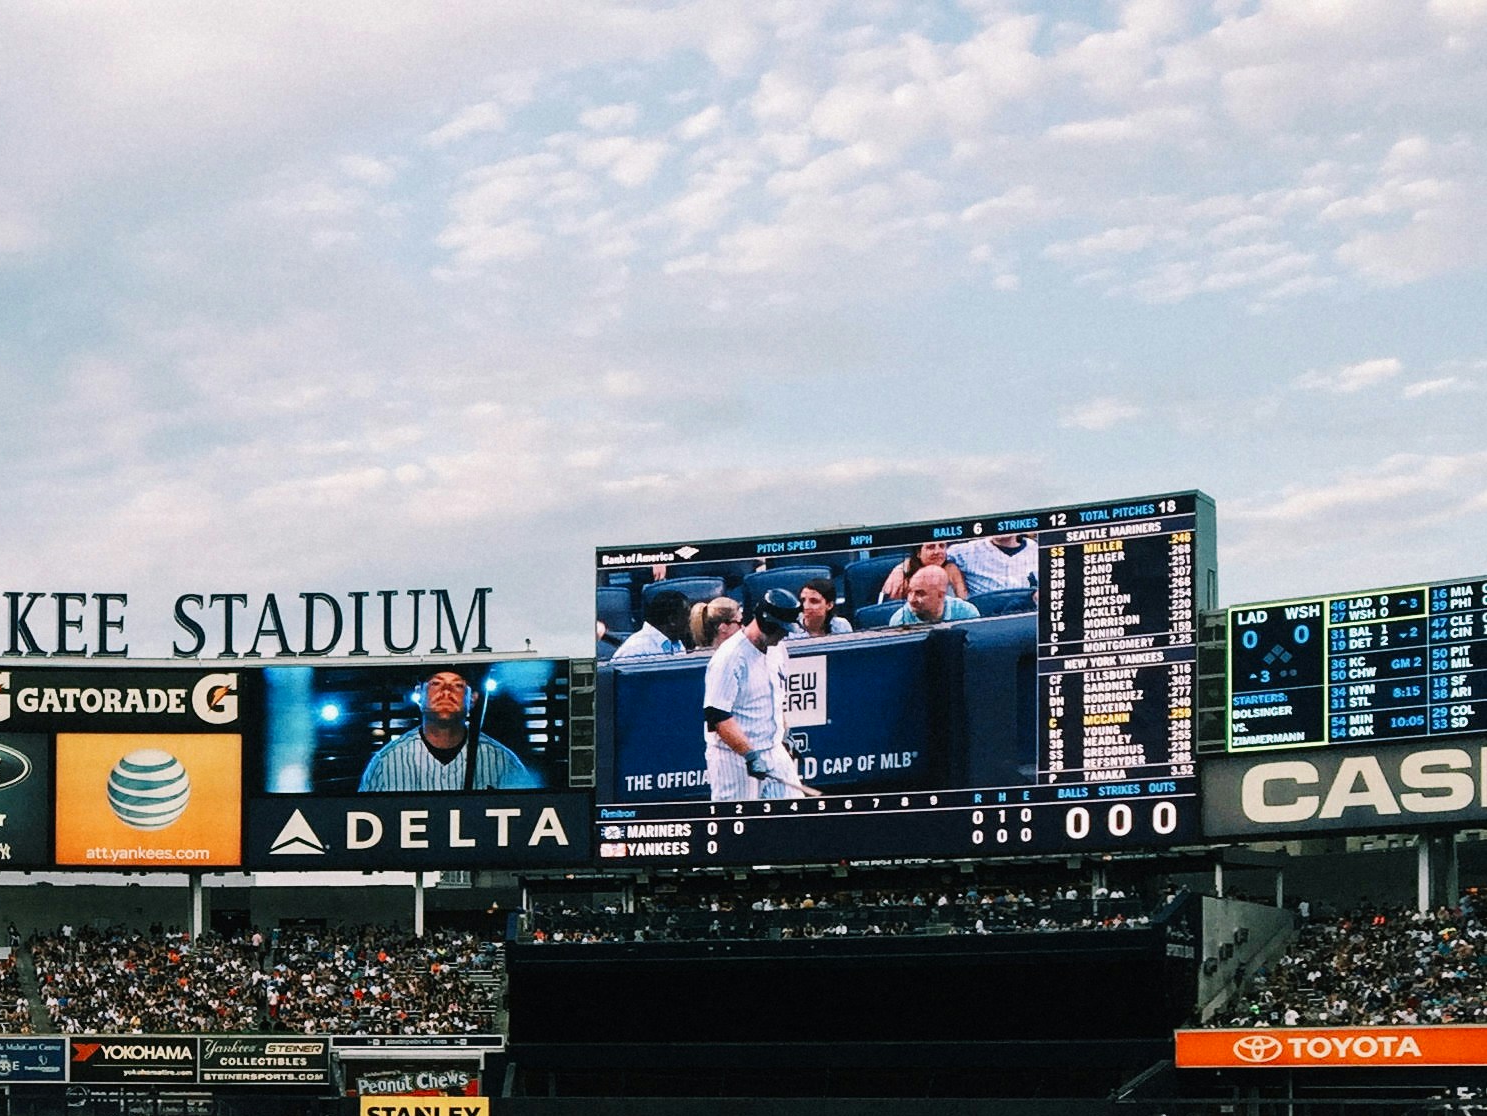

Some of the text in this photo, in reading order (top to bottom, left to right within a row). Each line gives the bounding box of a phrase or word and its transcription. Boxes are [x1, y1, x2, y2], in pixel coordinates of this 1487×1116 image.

[1079, 501, 1176, 522] TOTAL PITCHES 18
[998, 514, 1067, 532] STRIKES 12
[933, 526, 962, 538] BALLS
[1066, 522, 1161, 542] SEATTLE MARINERS
[851, 534, 873, 546] MPH
[757, 540, 817, 553] PITCH SPEED
[1084, 541, 1123, 553] MILLER
[1084, 552, 1125, 564] SEAGER
[1084, 564, 1113, 575] CANO
[1084, 574, 1112, 586] CRUZ
[1084, 585, 1118, 596] SMITH
[1451, 586, 1473, 597] MIA
[1084, 594, 1131, 608] JACKSON
[1349, 598, 1372, 609] LAD
[1451, 598, 1471, 609] PHI
[1084, 606, 1125, 618] ACKLEY
[1238, 605, 1320, 625] LAD WSH
[1349, 609, 1376, 621] WSH
[172, 587, 493, 659] STADIUM
[1084, 615, 1140, 629] MORRISON
[1450, 615, 1473, 627] CLE
[1084, 628, 1125, 640] ZUNINO
[1349, 627, 1372, 637] BAL
[1450, 627, 1472, 638] CIN
[1084, 637, 1154, 653] MONTGOMERY
[1349, 638, 1372, 648] DET
[1451, 645, 1471, 657] PIT
[1064, 652, 1164, 670] NEW YORK YANKEES
[1451, 657, 1473, 669] MIL
[1084, 669, 1138, 682] ELLSBURY
[1349, 667, 1376, 679] CHW
[1084, 680, 1133, 693] GARDNER
[1349, 684, 1375, 695] NYM
[1451, 687, 1472, 698] ARI
[17, 688, 187, 713] GATORADE
[1084, 690, 1144, 704] RODRIGUEZ
[1233, 693, 1287, 706] STARTERS:
[1349, 696, 1371, 707] STL
[1084, 702, 1133, 714] TEIXEIRA
[1233, 706, 1293, 719] BOLSINGER
[1451, 705, 1475, 716] COL
[1084, 713, 1130, 725] MCCANN
[1349, 714, 1373, 725] MIN
[1084, 725, 1120, 736] YOUNG
[1349, 725, 1374, 737] OAK
[1084, 735, 1132, 747] HEADLEY
[1233, 732, 1305, 746] ZIMMERMANN
[1084, 744, 1144, 758] GREGORIUS
[823, 757, 853, 774] CAP
[1084, 755, 1145, 768] REFSNYDER
[1084, 770, 1126, 781] TANAKA
[625, 775, 653, 791] THE
[1057, 782, 1176, 798] BALLS STRIKES OUTS
[1066, 802, 1177, 840] 0 0 0
[346, 807, 569, 849] DELTA
[627, 823, 691, 838] MARINERS
[86, 847, 209, 862] att.yankees.com
[628, 842, 689, 856] YANKEES
[101, 1046, 192, 1060] YOKOHAMA
[204, 1040, 256, 1059] Yankees
[1288, 1036, 1422, 1059] TOYOTA
[220, 1058, 307, 1066] COLLECTIBLES
[358, 1075, 413, 1094] Peanut
